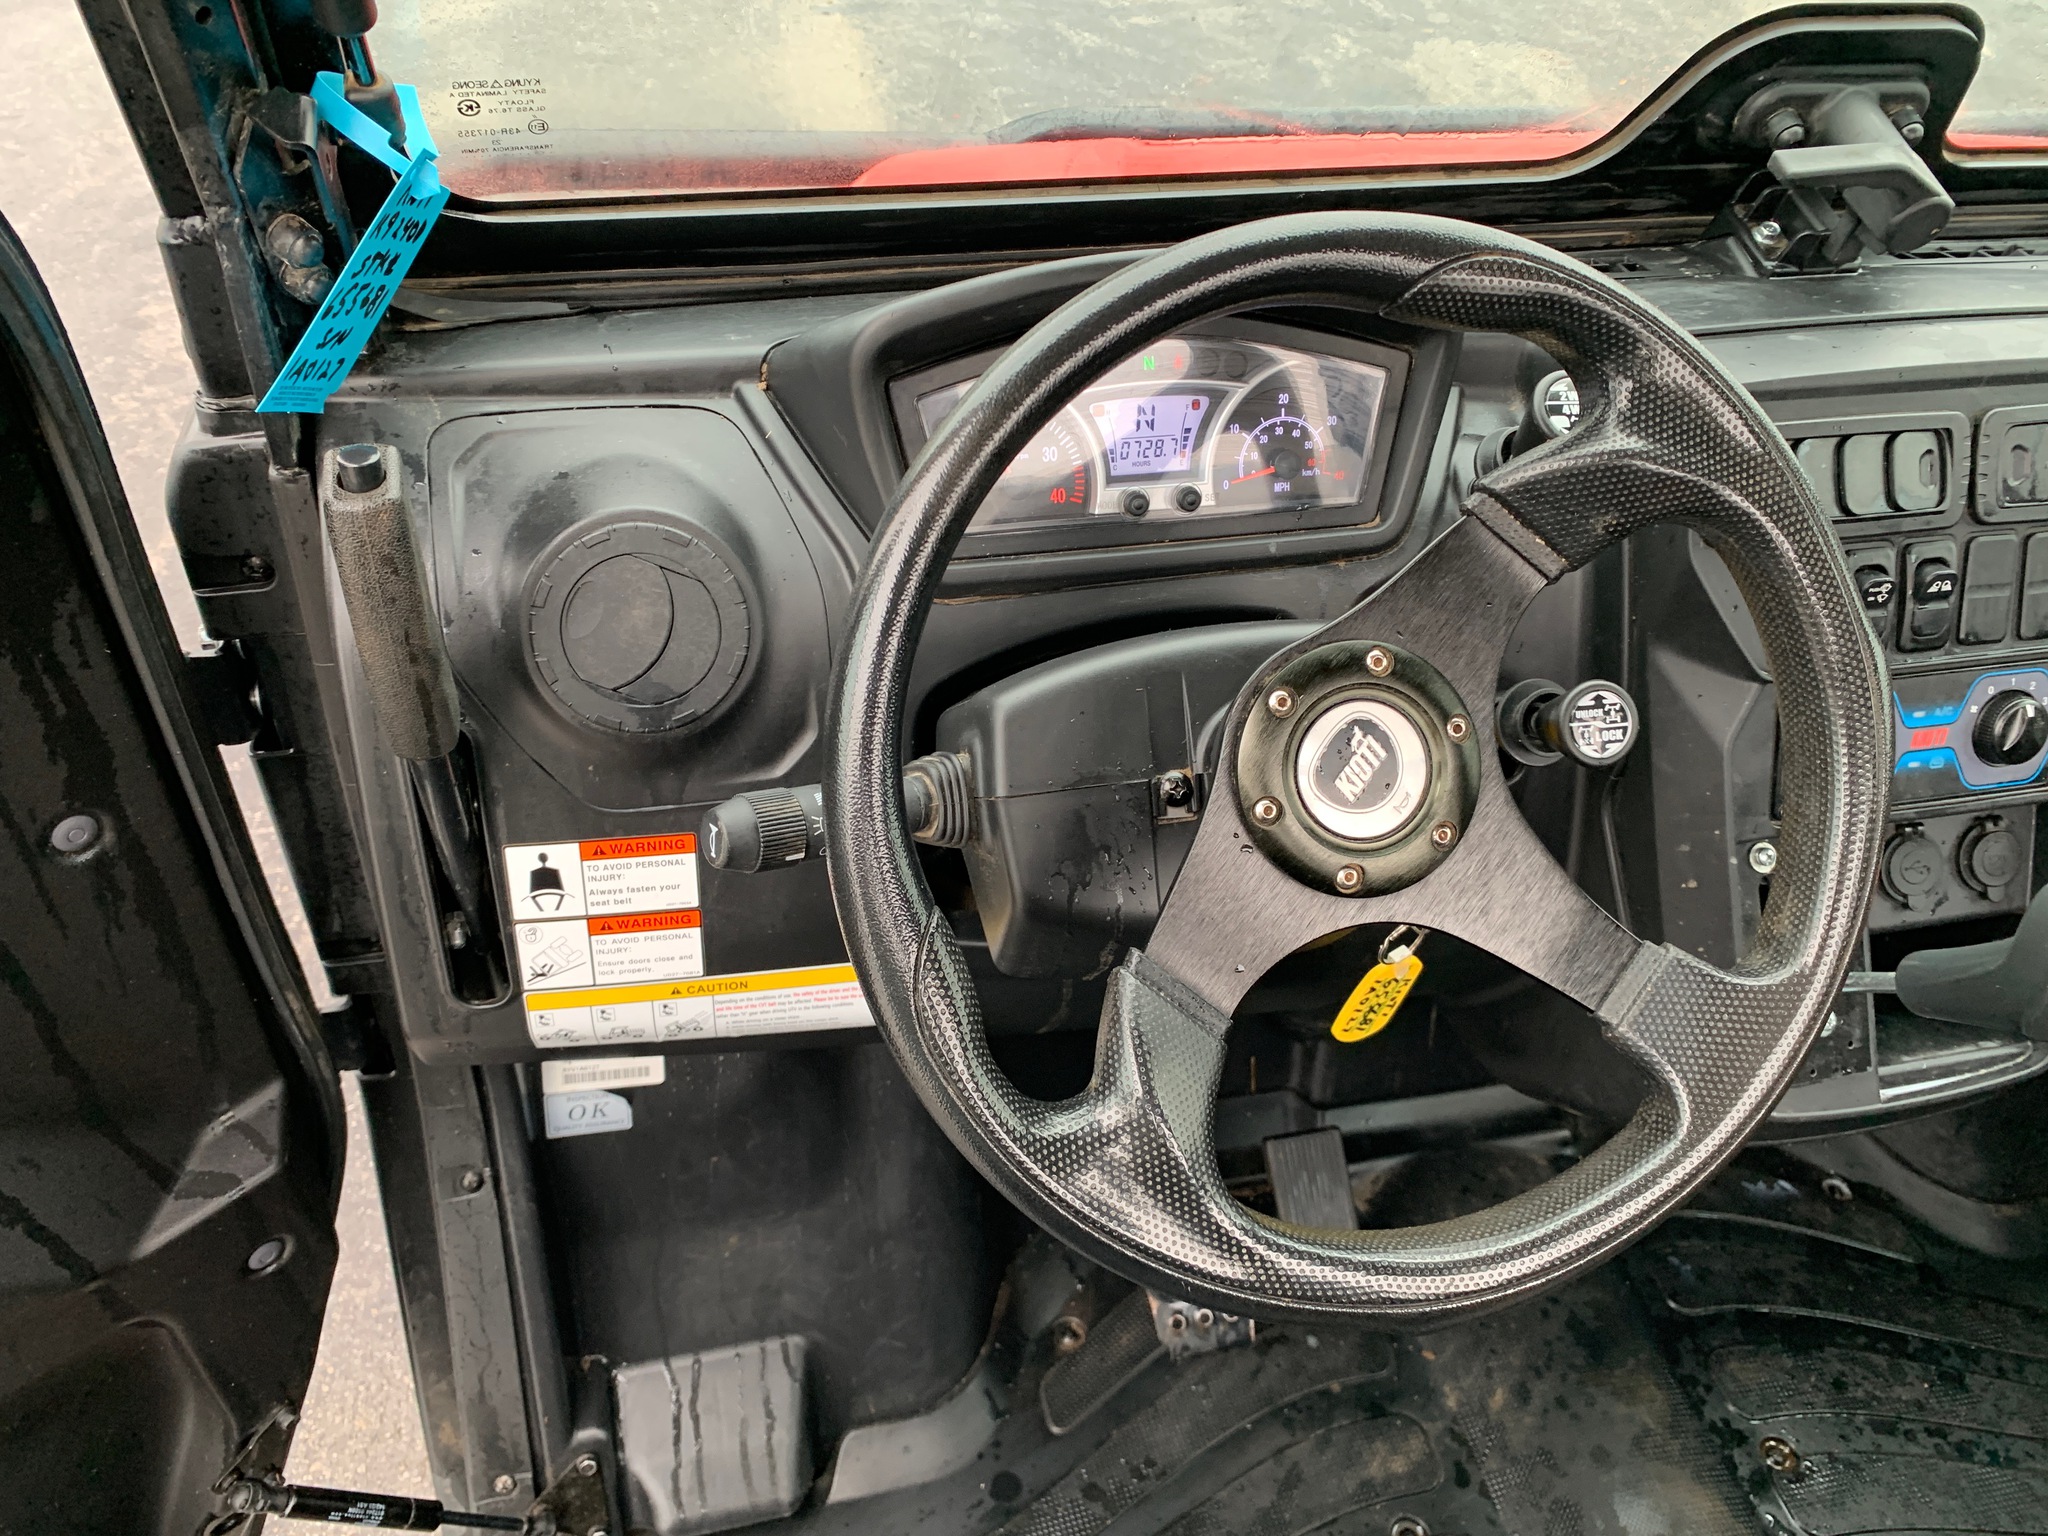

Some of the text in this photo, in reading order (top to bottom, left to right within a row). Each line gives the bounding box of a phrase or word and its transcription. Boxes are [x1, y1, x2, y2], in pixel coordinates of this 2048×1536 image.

[321, 282, 390, 320] 655681
[1143, 355, 1155, 370] N
[1278, 393, 1289, 404] 20
[1136, 403, 1156, 433] N
[1326, 415, 1338, 426] 30
[1229, 424, 1240, 434] 10
[1275, 427, 1283, 436] 30
[1292, 429, 1301, 438] 40
[1259, 435, 1268, 443] 20
[1120, 438, 1179, 461] 0728.7
[1304, 441, 1313, 450] 50
[1042, 446, 1058, 462] 30
[1251, 452, 1259, 460] 10
[1132, 460, 1151, 468] HOURS
[1302, 467, 1320, 477] km/h
[1223, 481, 1229, 490] 0
[1274, 482, 1290, 492] MPH
[1050, 487, 1066, 504] 40
[2011, 677, 2016, 686] 1
[2029, 681, 2037, 690] 2
[1988, 686, 1995, 695] 0
[2042, 696, 2048, 706] 3
[1575, 708, 1604, 719] UNLOCK
[1595, 729, 1624, 741] LOCK
[609, 838, 686, 855] WARNING
[586, 858, 686, 873] TO AVOID PERSONAL
[587, 873, 626, 883] INJURY:
[588, 883, 681, 898] Always fasten your
[590, 896, 632, 908] seat belt
[616, 914, 692, 930] WARNING
[611, 936, 640, 945] AVOID
[644, 932, 693, 943] PERSONAL
[595, 946, 632, 955] INJURY:
[628, 957, 651, 965] doors
[654, 955, 675, 963] close
[619, 966, 655, 976] properly.
[686, 980, 749, 994] CAUTION
[568, 1101, 611, 1121] OK
